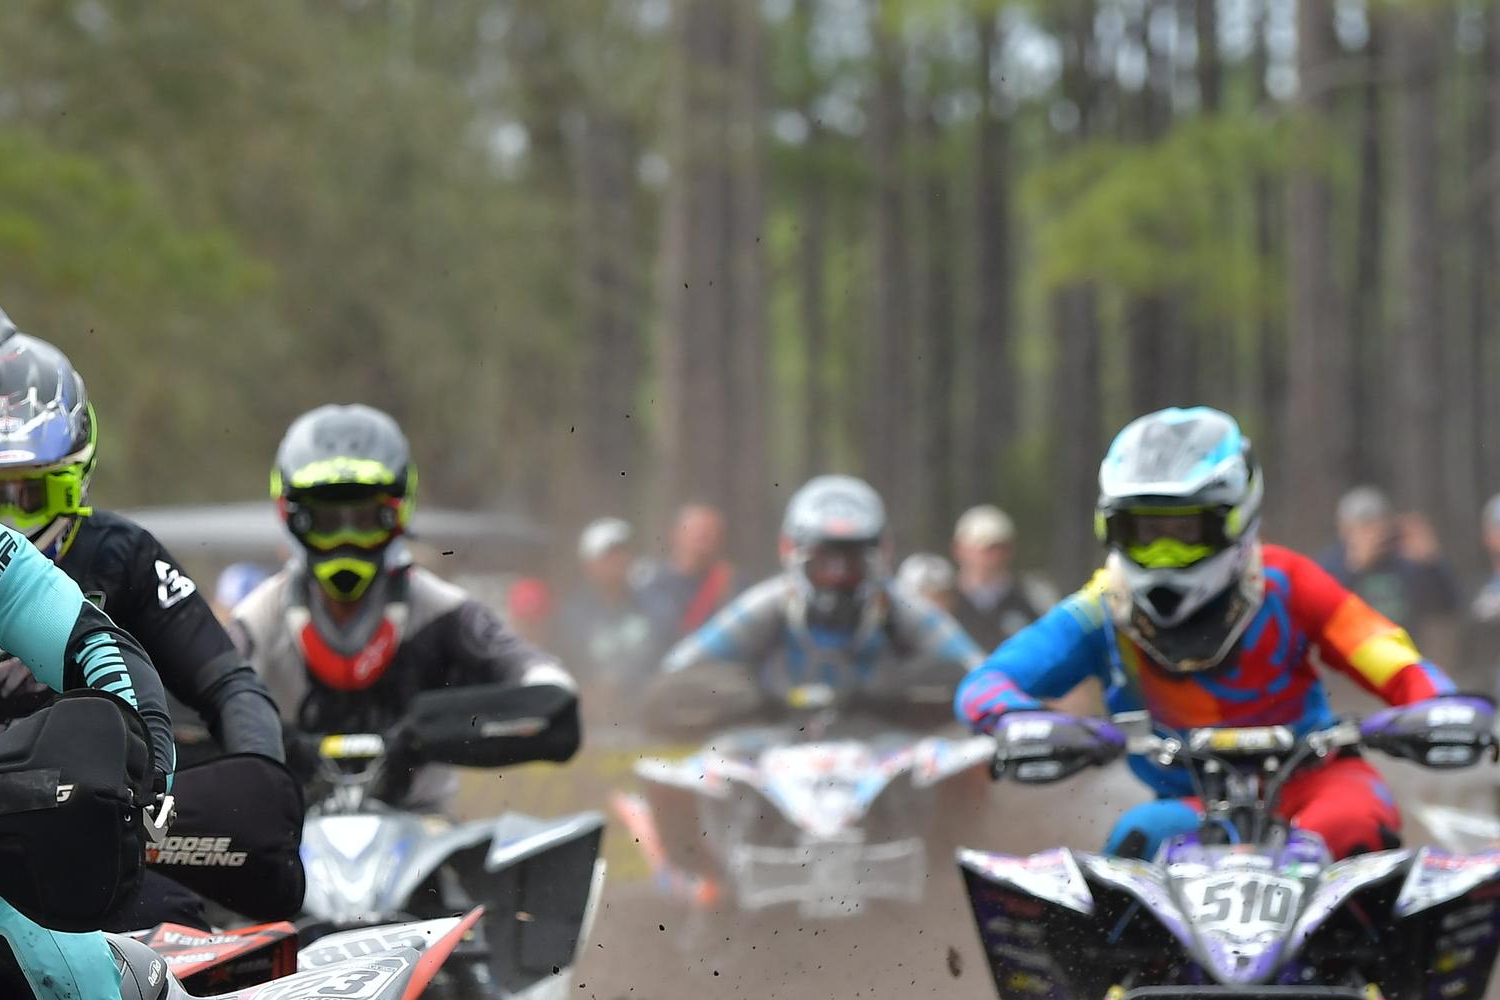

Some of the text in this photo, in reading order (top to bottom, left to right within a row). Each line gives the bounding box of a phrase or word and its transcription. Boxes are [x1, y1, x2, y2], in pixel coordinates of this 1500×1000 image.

[157, 850, 248, 867] RACING
[1199, 879, 1290, 927] 510
[305, 929, 426, 967] 805
